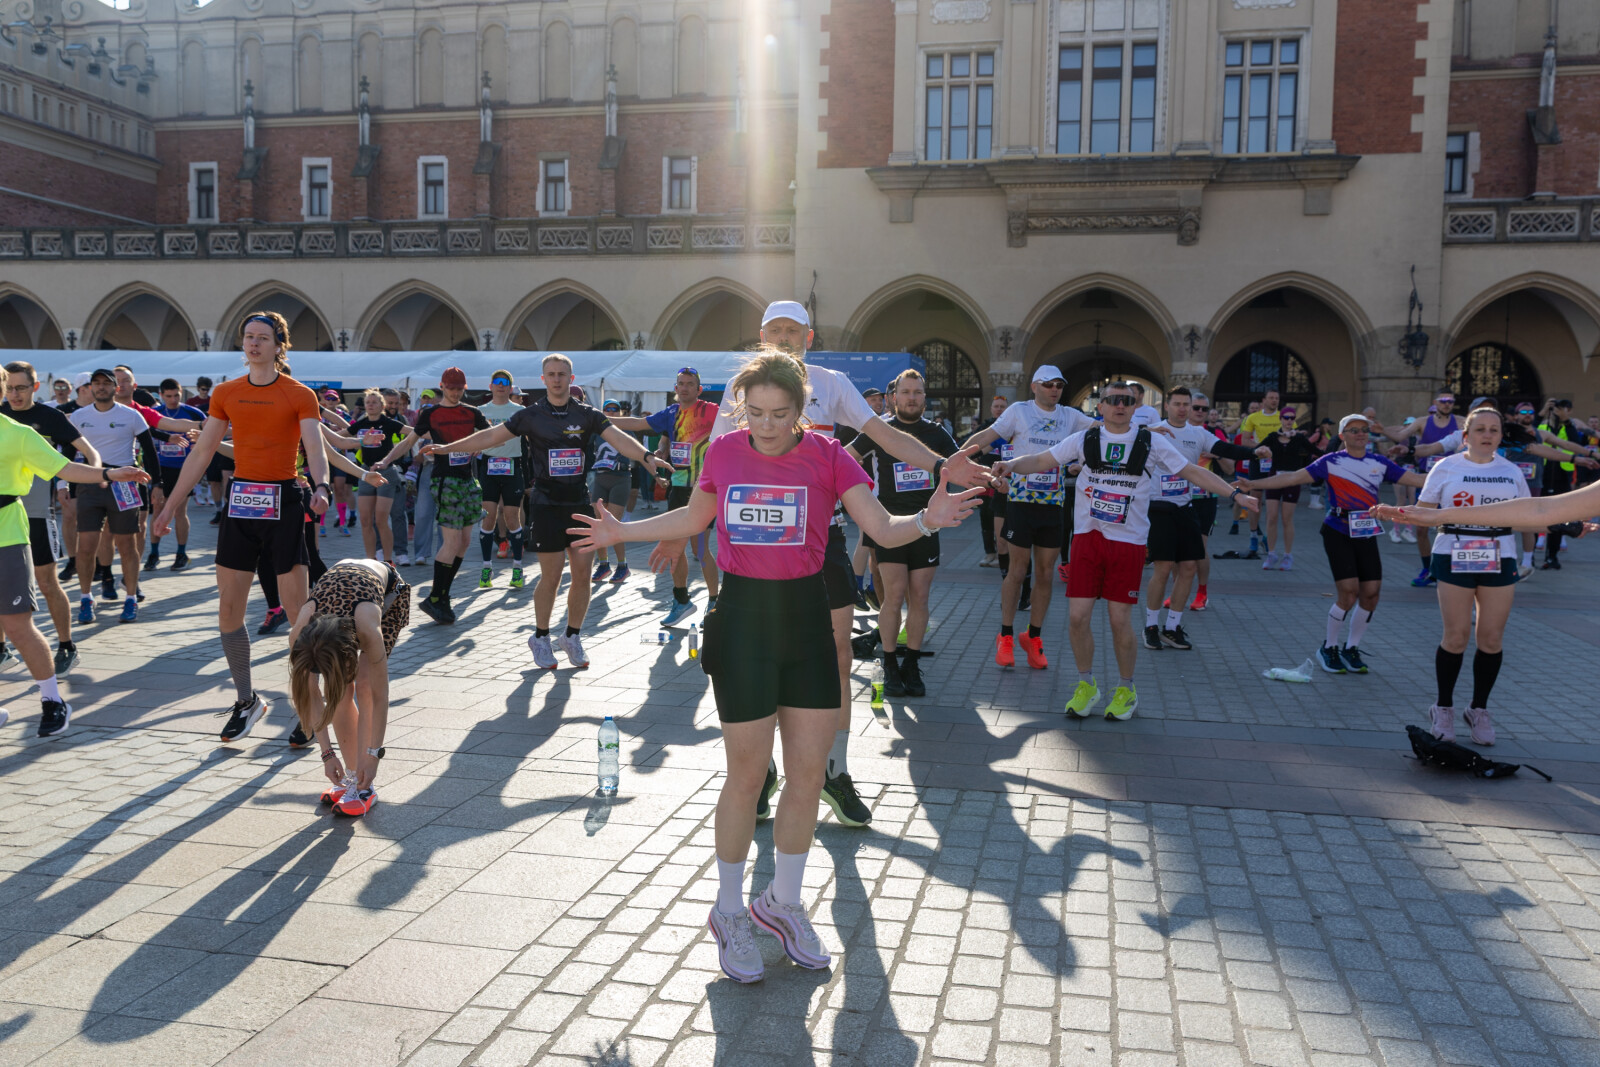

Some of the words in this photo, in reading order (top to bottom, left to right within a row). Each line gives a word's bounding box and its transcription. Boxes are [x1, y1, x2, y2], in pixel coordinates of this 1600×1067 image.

[552, 459, 579, 467] 2865
[902, 471, 924, 481] 867
[1035, 474, 1052, 482] 491
[233, 495, 272, 506] 8054
[1094, 500, 1122, 513] 6753
[739, 507, 784, 524] 6113
[1457, 551, 1490, 560] 8154
